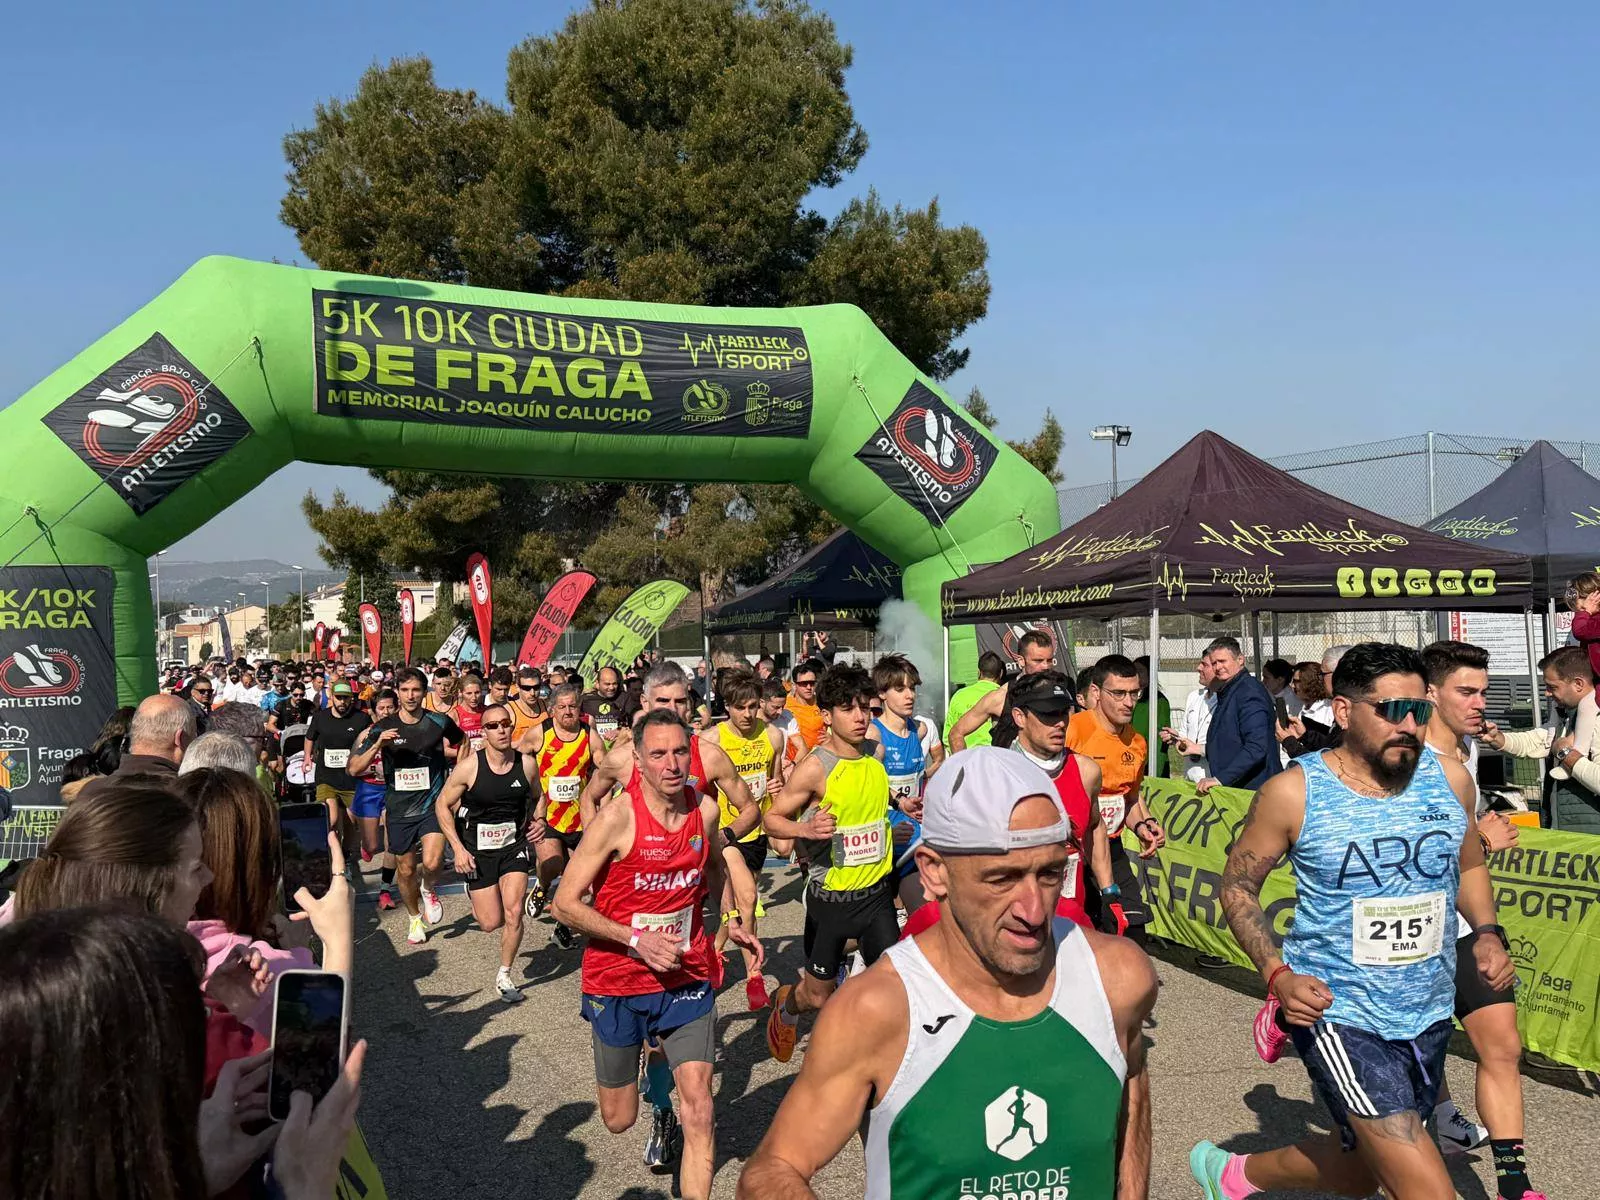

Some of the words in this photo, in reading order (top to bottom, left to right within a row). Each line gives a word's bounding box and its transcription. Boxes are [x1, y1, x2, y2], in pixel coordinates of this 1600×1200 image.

[323, 297, 383, 338] 5K
[394, 305, 476, 346] 10K
[488, 313, 643, 357] CIUDAD
[719, 335, 791, 349] FARTLECK
[324, 339, 415, 387] DE
[436, 349, 653, 401] FRAGA
[726, 354, 793, 371] SPORT
[120, 368, 153, 390] FRAGA
[161, 364, 191, 379] BAJO
[327, 389, 450, 416] MEMORIAL
[455, 399, 550, 418] JOAQUÍN
[555, 405, 652, 422] CALUCHO
[120, 412, 222, 493] ATLETISMO
[1211, 565, 1274, 585] Fartleck
[966, 583, 1114, 613] www.fartlecksport.com
[0, 609, 93, 629] RAGA
[539, 602, 570, 627] CAJÓN
[613, 605, 657, 640] CAJÓN
[0, 695, 82, 708] ATLETISMO
[843, 831, 879, 847] 1010
[848, 846, 877, 856] ANDRES
[1337, 830, 1453, 890] ARG
[1485, 847, 1600, 883] ARTLECK
[1496, 887, 1594, 924] PORT
[1392, 942, 1418, 951] EMA
[960, 1177, 984, 1193] EL
[989, 1170, 1040, 1193] RETO
[1045, 1166, 1071, 1186] DE
